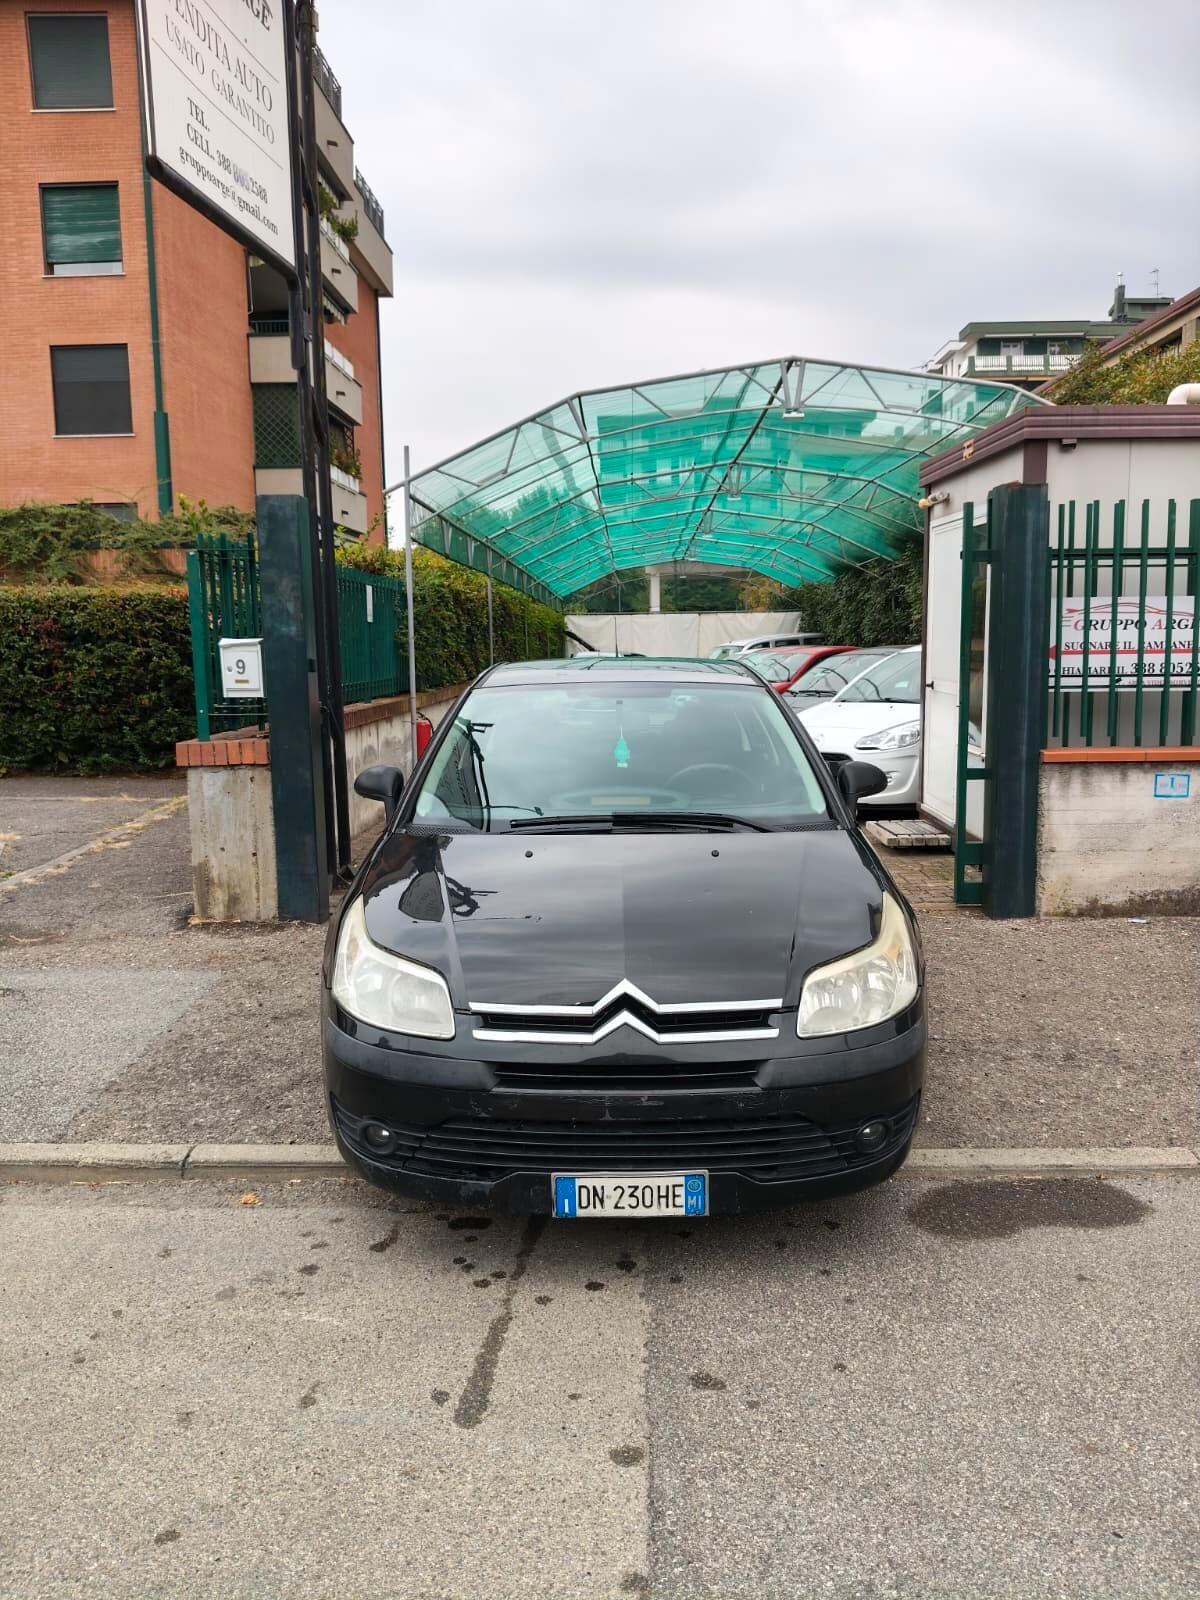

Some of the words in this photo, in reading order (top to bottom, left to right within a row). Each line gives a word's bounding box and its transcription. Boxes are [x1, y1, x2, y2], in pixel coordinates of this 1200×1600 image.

[165, 14, 205, 75] USATO
[212, 69, 275, 144] GARANTITO
[234, 56, 272, 111] AUTO
[187, 97, 210, 132] TEL.
[187, 123, 215, 160] CELL.
[216, 149, 232, 175] 388
[249, 176, 268, 203] 2588
[1123, 641, 1136, 650] IL
[236, 658, 246, 675] 9
[577, 1184, 605, 1210] DN
[613, 1183, 684, 1210] 230HE
[687, 1195, 702, 1210] MI
